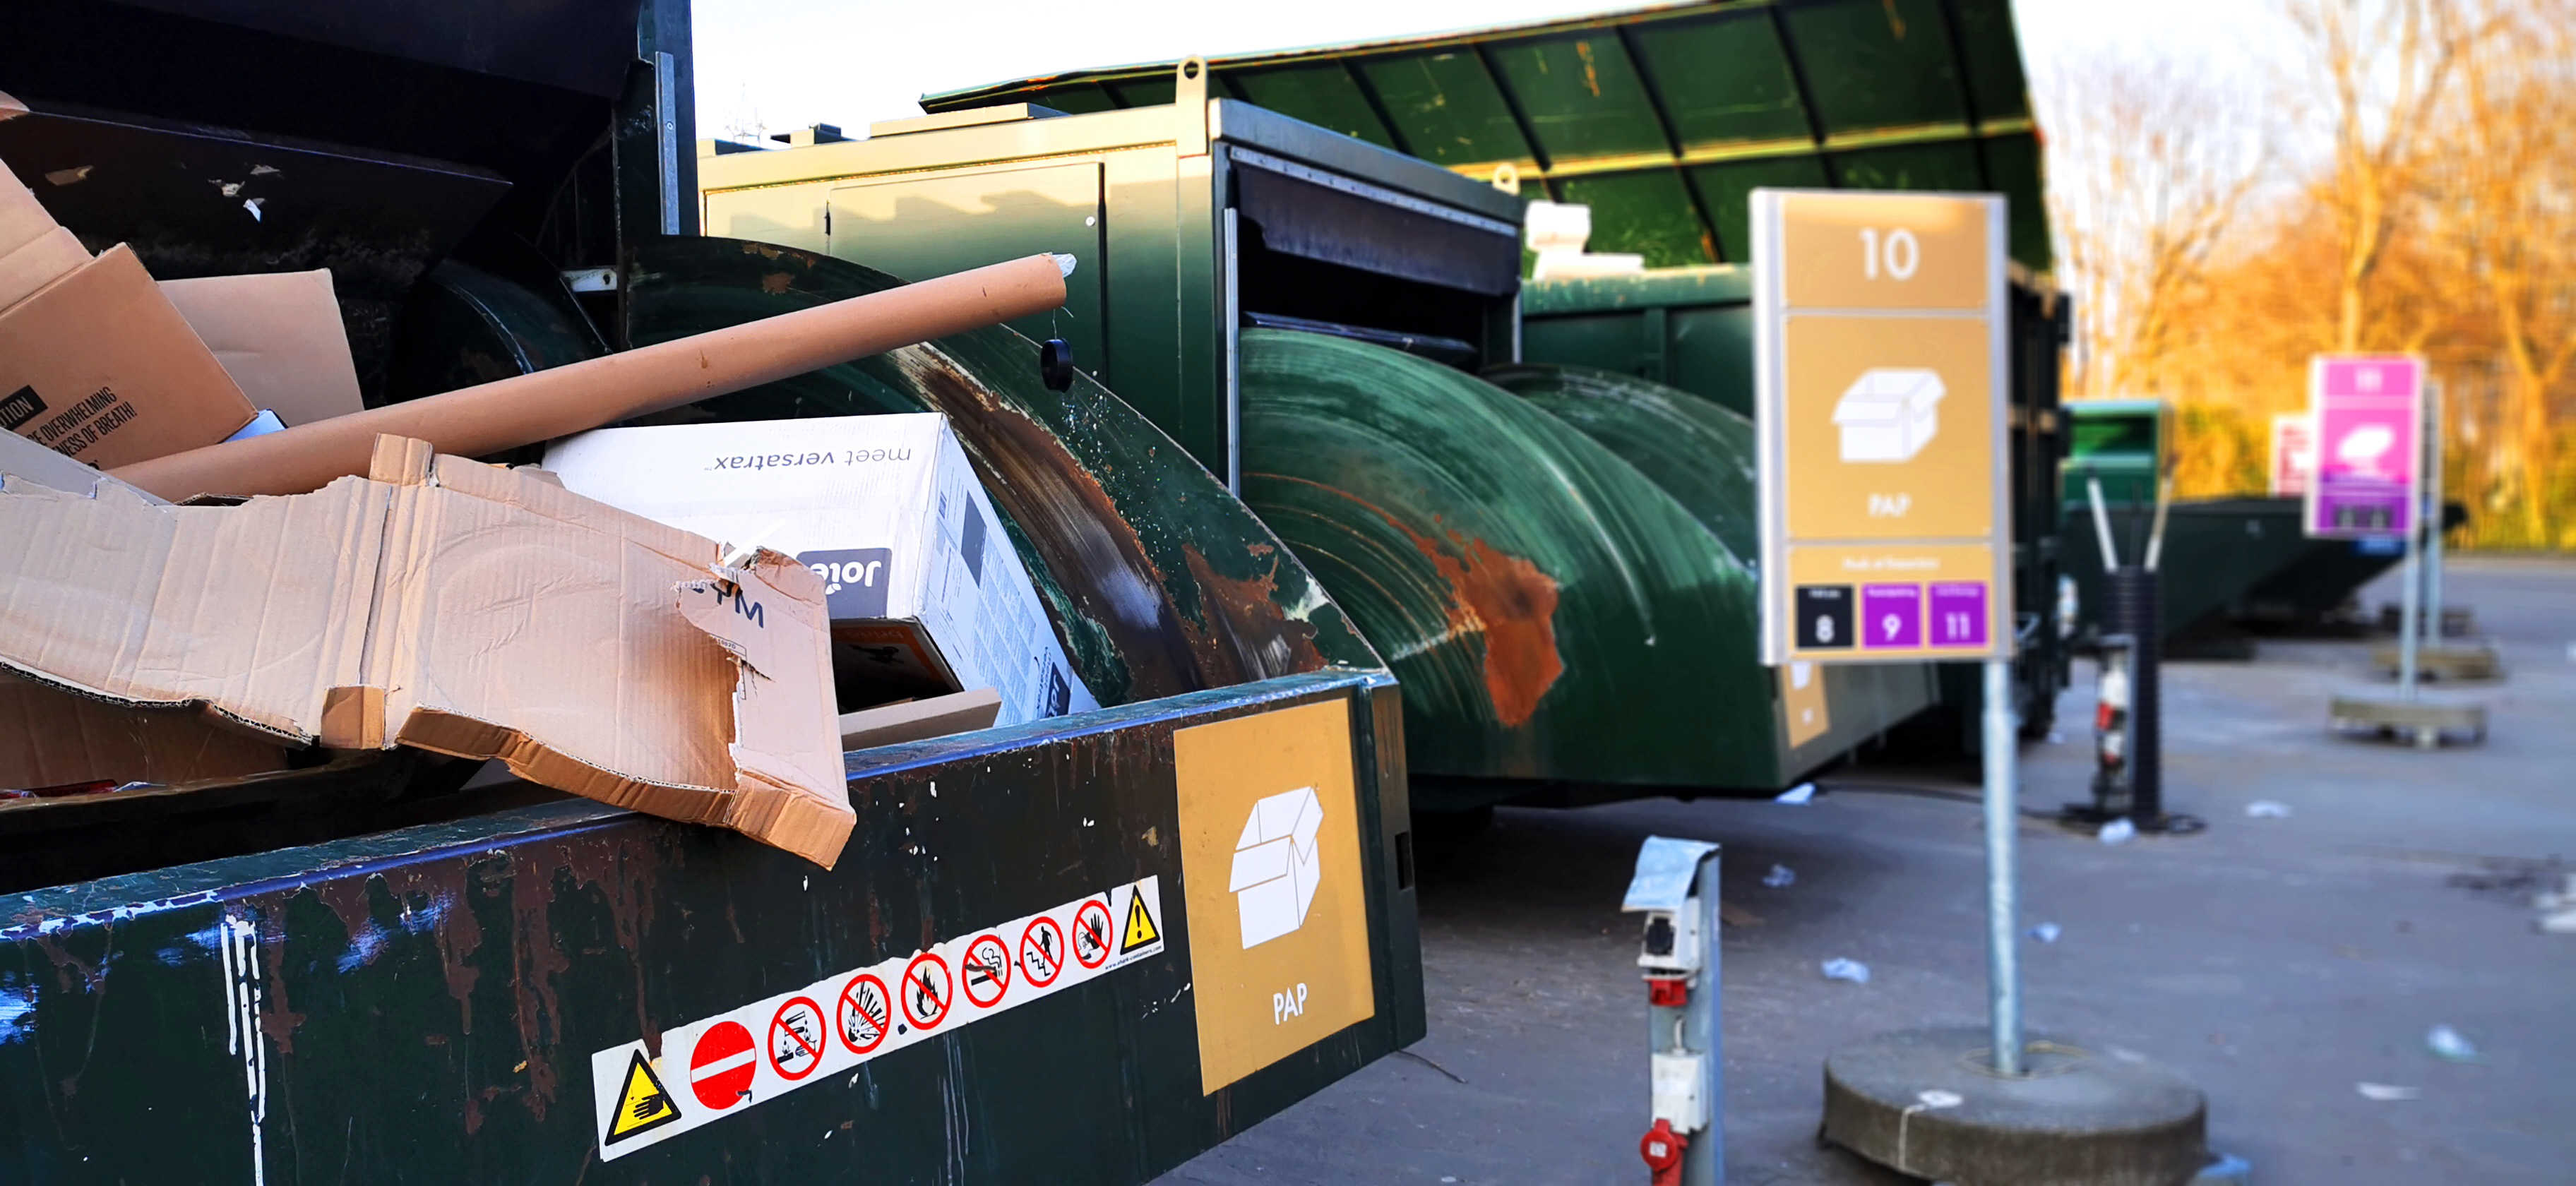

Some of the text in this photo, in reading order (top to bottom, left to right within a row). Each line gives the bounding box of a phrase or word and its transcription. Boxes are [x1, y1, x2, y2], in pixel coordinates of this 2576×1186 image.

[1859, 227, 1921, 281] 10
[40, 386, 117, 442] OVERWHELMING
[52, 401, 138, 457] NESS OF BREATH!
[714, 448, 912, 471] meet versatrax
[1815, 614, 1835, 643] 8
[1881, 612, 1902, 641] 9
[1945, 611, 1971, 640] 11
[1273, 982, 1308, 1025] PAP
